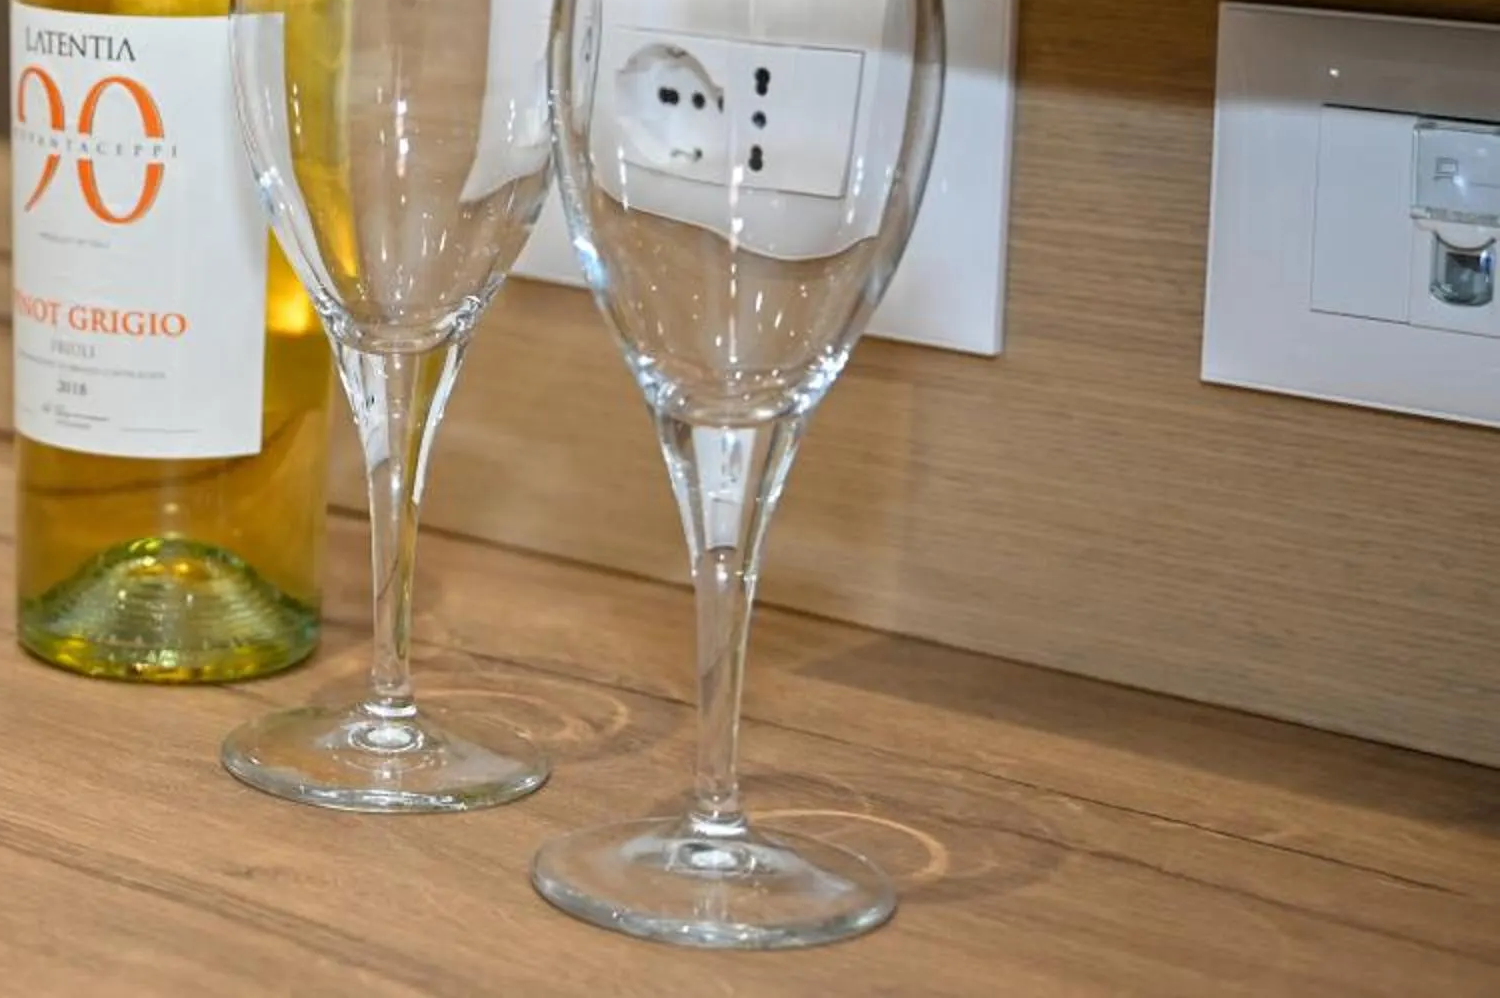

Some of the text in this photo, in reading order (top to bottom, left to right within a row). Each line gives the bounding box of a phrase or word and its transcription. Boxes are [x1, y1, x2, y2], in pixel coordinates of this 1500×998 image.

[25, 25, 136, 62] LATENTIA
[17, 63, 165, 225] 90
[14, 291, 188, 338] NOT GRIGIO
